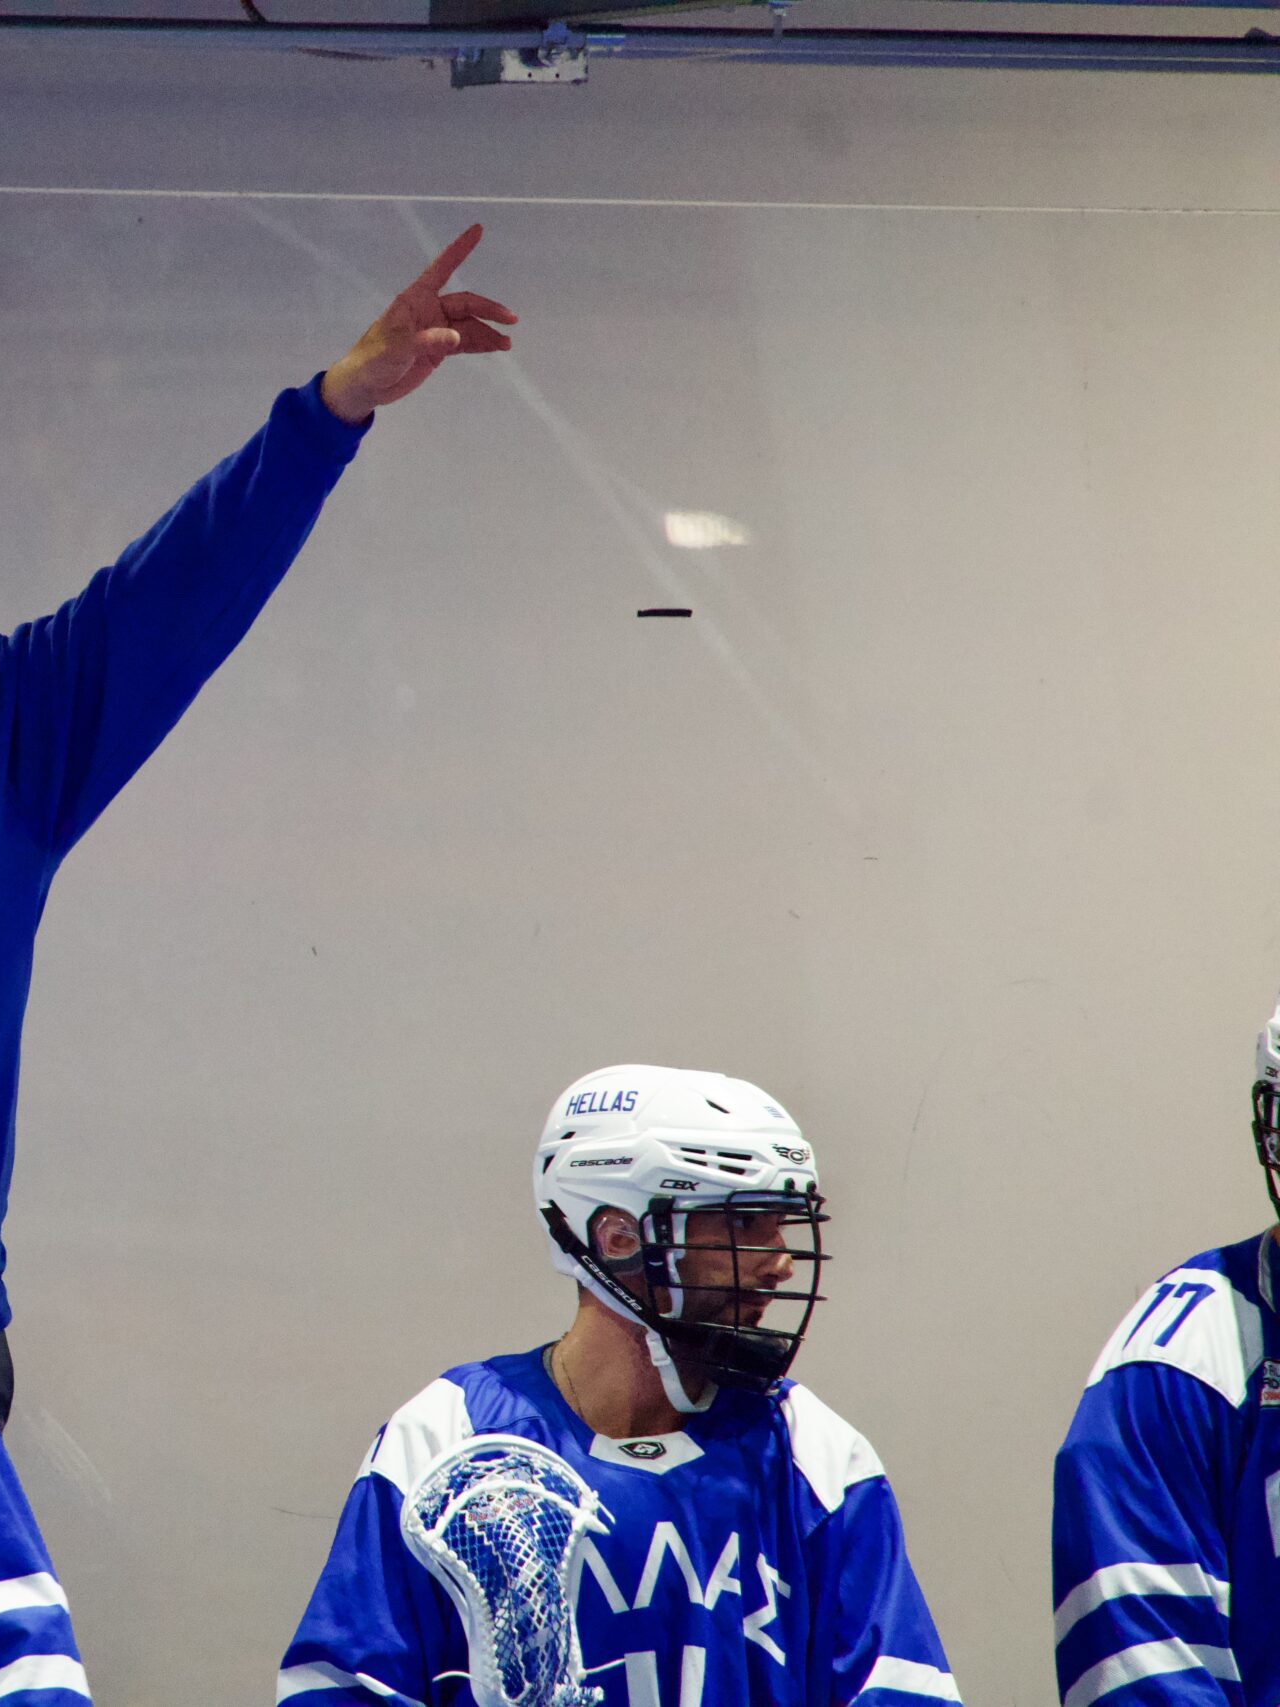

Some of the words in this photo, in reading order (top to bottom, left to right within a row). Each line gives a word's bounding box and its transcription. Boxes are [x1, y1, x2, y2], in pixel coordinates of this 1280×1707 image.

[565, 1090, 639, 1117] HELLAS
[570, 1155, 634, 1168] cascade
[659, 1178, 700, 1192] CBX
